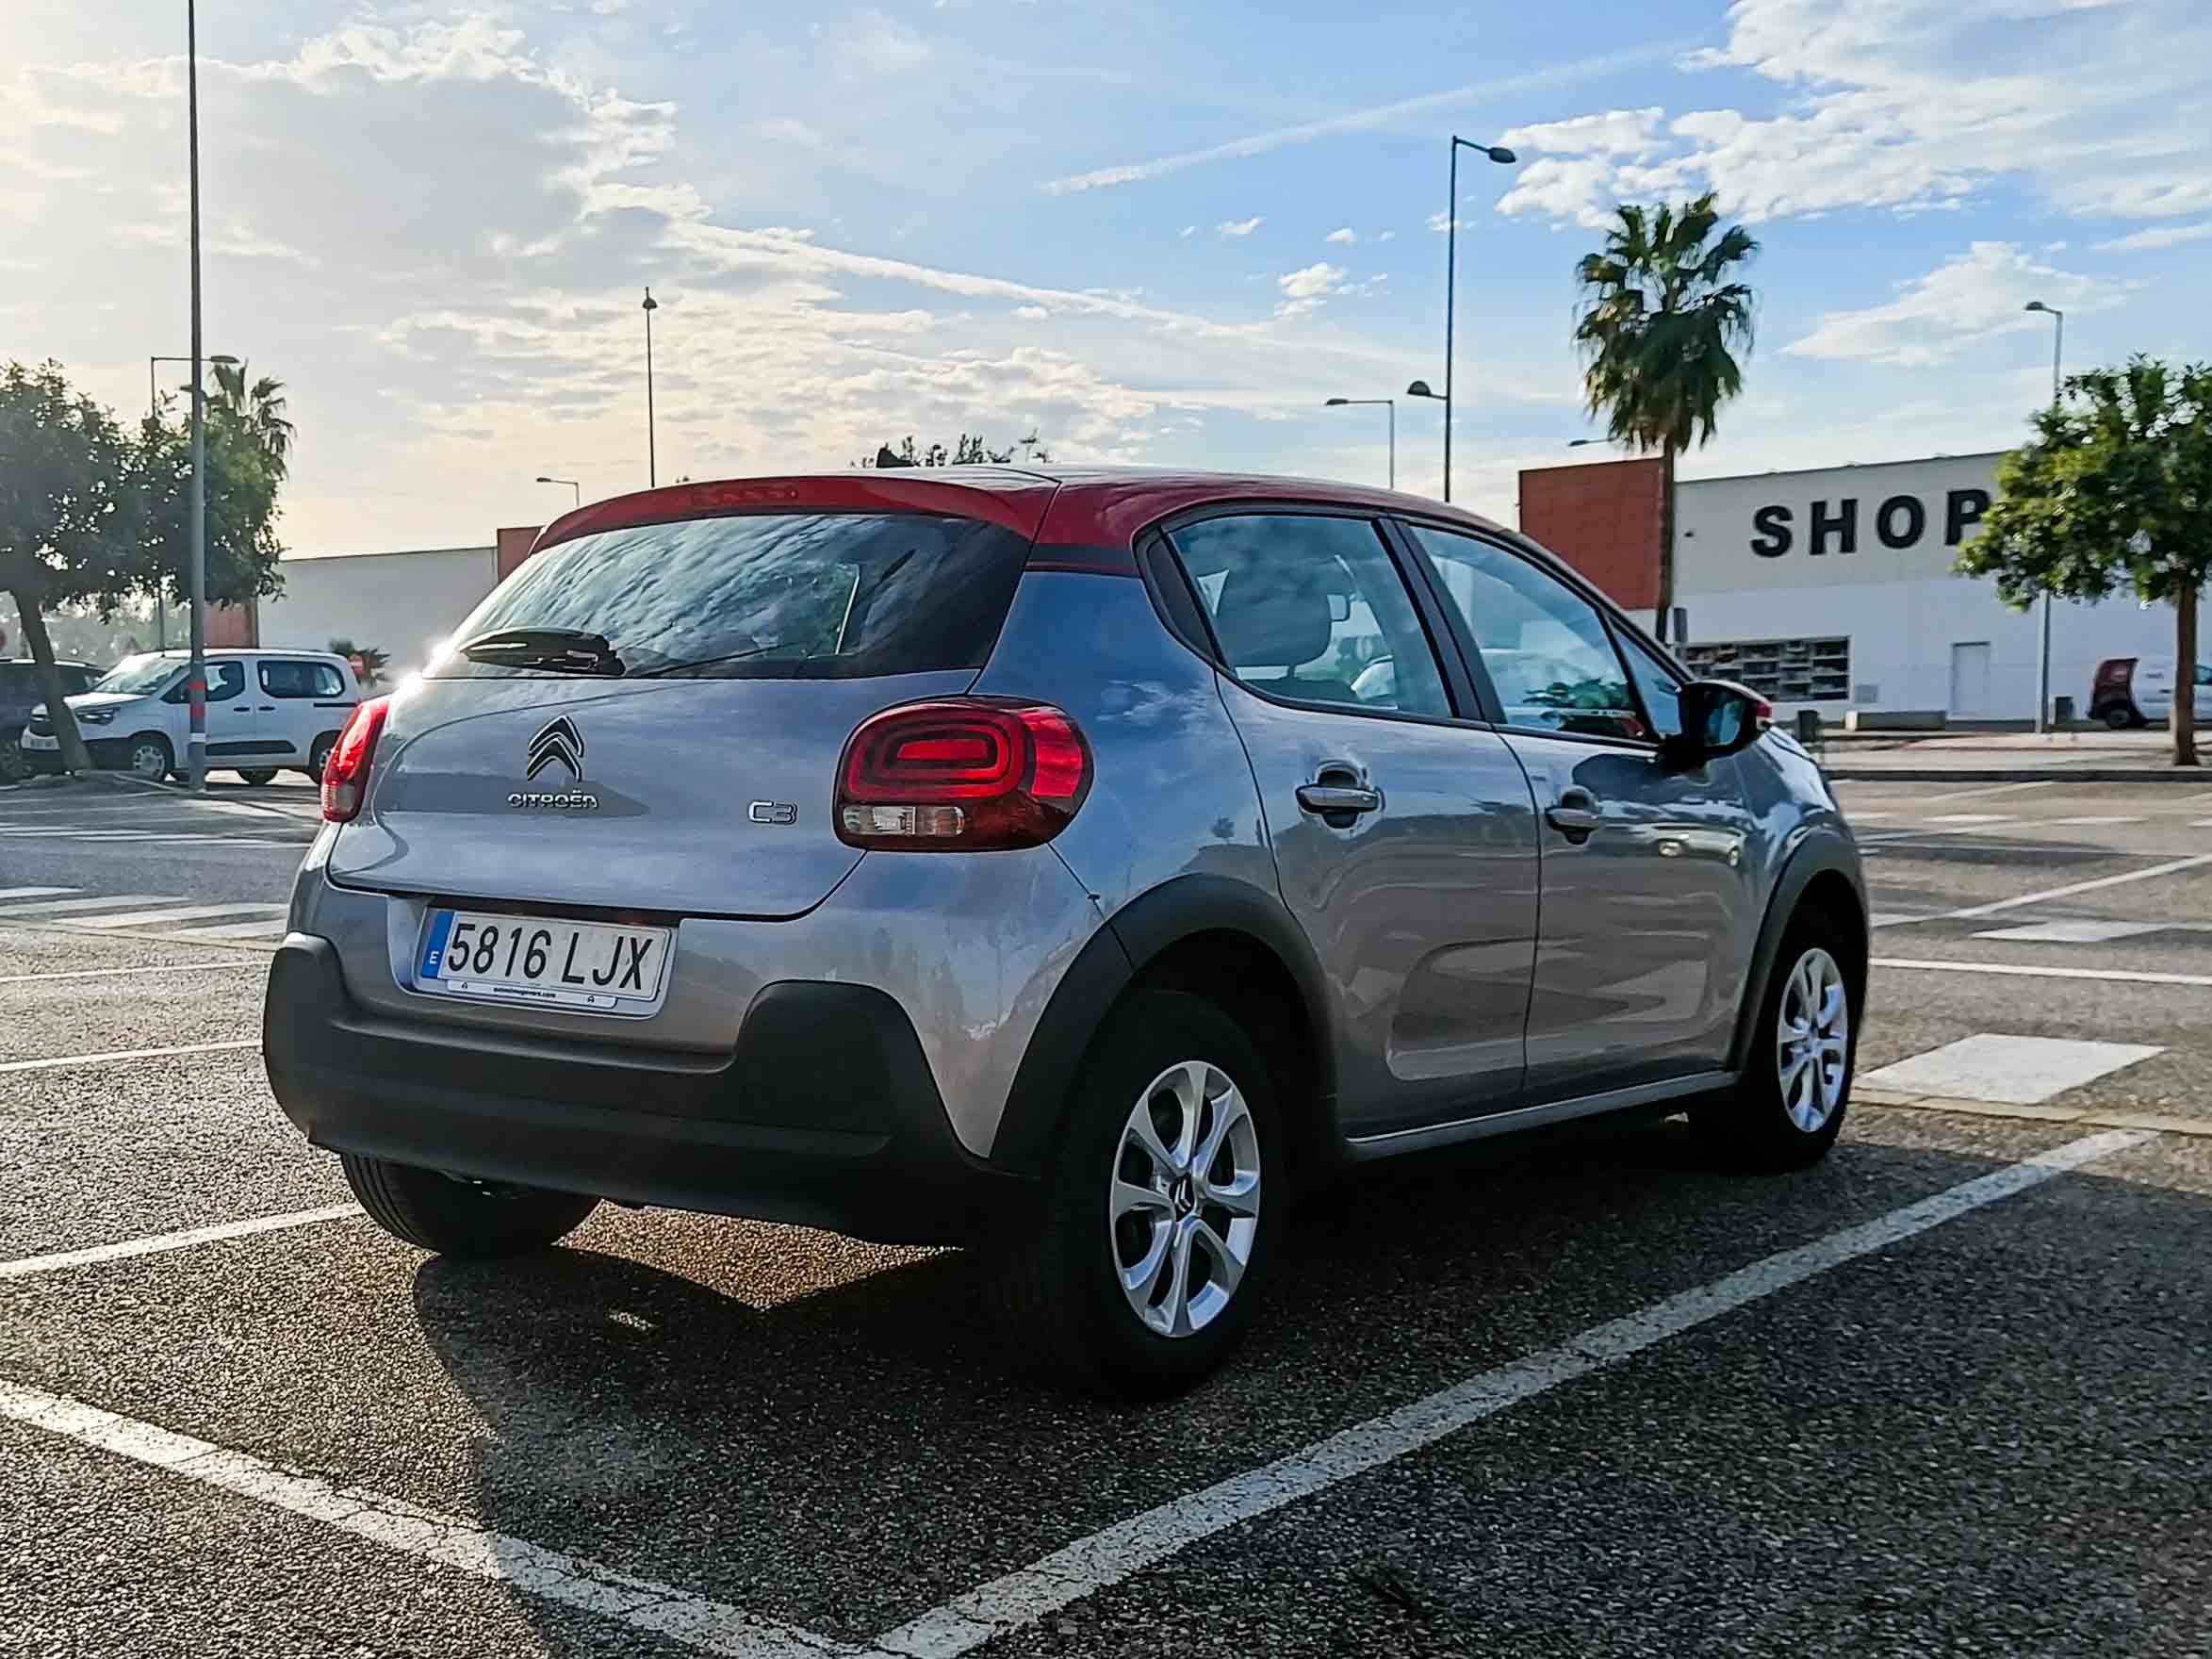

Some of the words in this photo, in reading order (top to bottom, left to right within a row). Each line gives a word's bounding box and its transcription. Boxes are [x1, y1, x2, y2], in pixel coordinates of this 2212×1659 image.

[507, 788, 598, 808] CITROËN
[747, 801, 798, 825] C3
[429, 950, 440, 964] E
[448, 923, 551, 978] 5816
[562, 931, 653, 991] LJX
